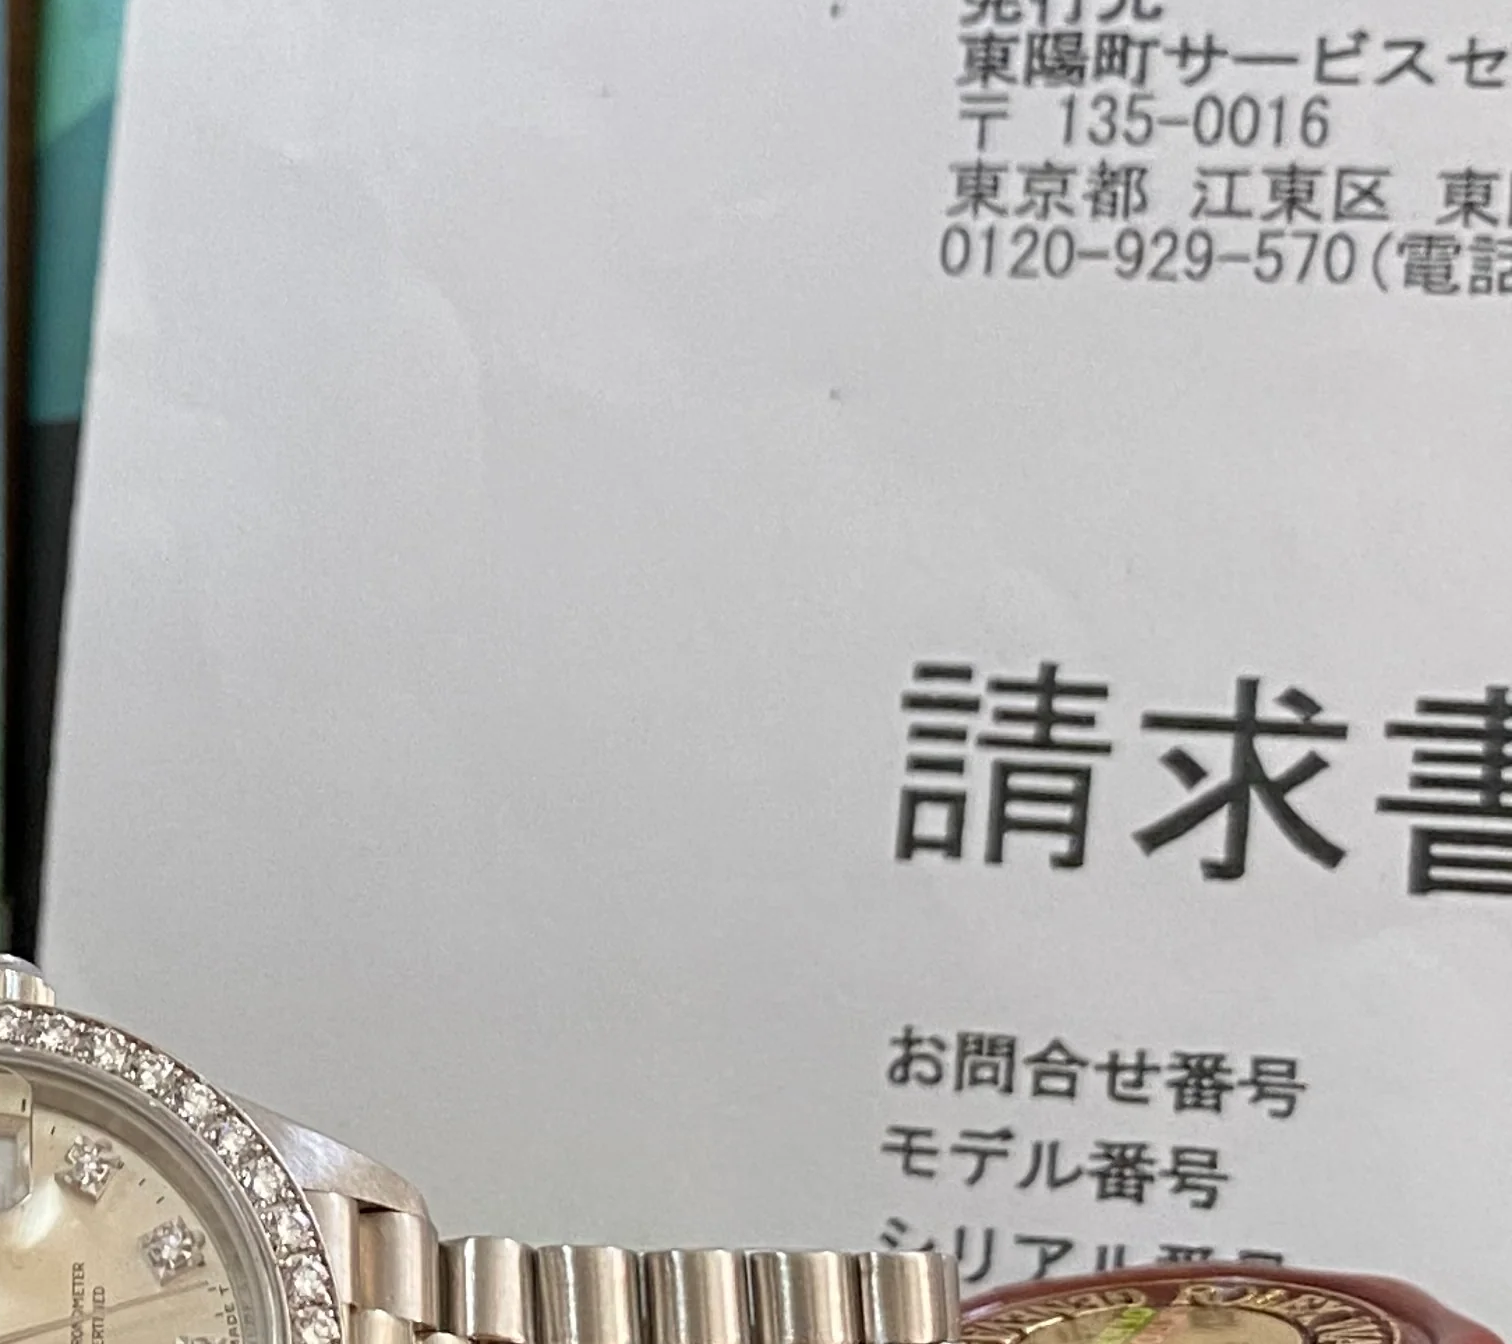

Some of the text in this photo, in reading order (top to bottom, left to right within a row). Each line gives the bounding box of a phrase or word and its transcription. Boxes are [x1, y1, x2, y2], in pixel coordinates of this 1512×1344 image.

[956, 27, 1508, 87] 東陽町サービスセ
[1059, 92, 1331, 149] 135-0016
[945, 157, 1149, 220] 東京都
[1190, 160, 1391, 225] 江東区
[894, 661, 1512, 896] 請求書
[886, 1024, 1308, 1119] お問合せ番号
[882, 1125, 1230, 1209] モデル番号
